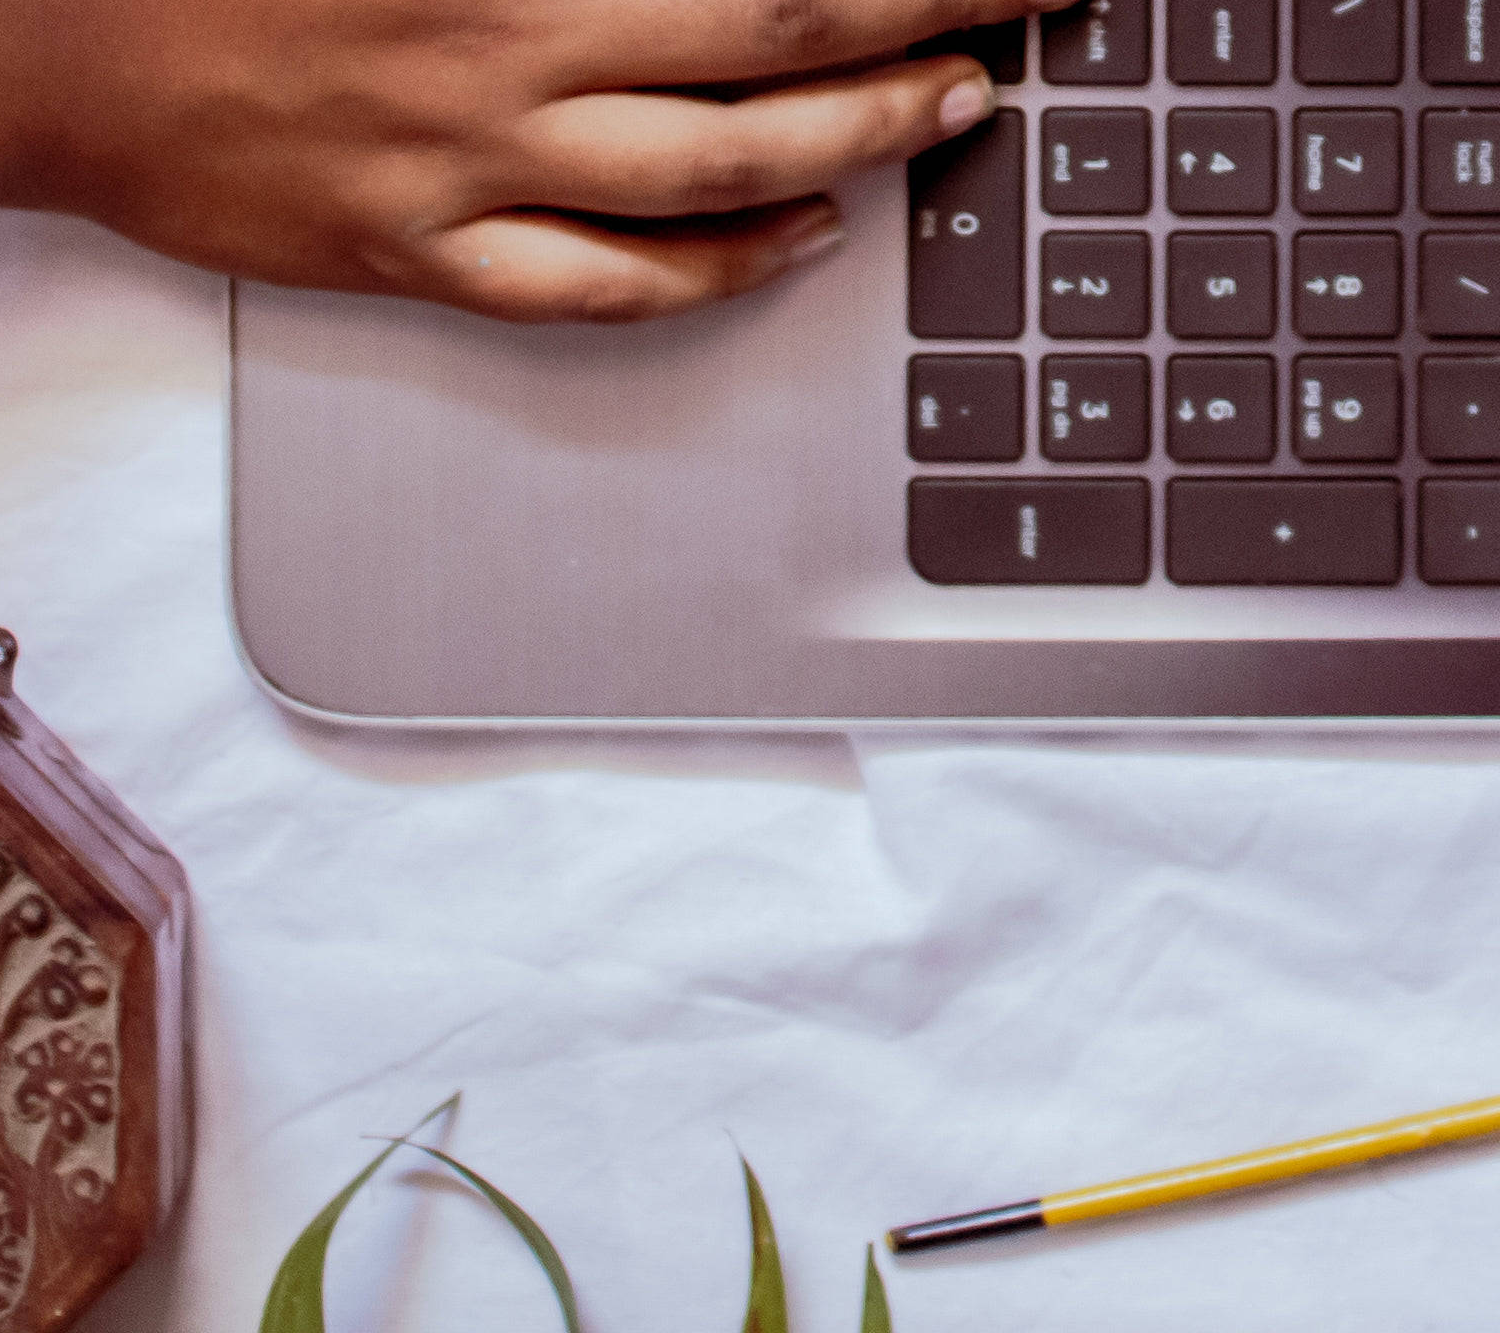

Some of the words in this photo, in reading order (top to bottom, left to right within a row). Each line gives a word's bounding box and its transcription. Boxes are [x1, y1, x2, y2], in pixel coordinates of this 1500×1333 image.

[1213, 7, 1232, 62] enter
[1052, 142, 1072, 183] end
[1207, 151, 1236, 175] 4
[1304, 133, 1325, 193] home
[1334, 153, 1363, 174] 7
[1474, 139, 1494, 186] num
[949, 211, 980, 237] 0
[1078, 275, 1110, 297] 2
[1204, 276, 1236, 299] 5
[1331, 273, 1363, 298] 8
[1048, 378, 1068, 410] pg
[1300, 378, 1322, 409] pg
[1078, 400, 1110, 421] 3
[1204, 397, 1236, 423] 6
[1330, 397, 1362, 422] 9
[1050, 411, 1071, 440] dn
[1302, 411, 1322, 439] up
[1018, 505, 1038, 559] enter
